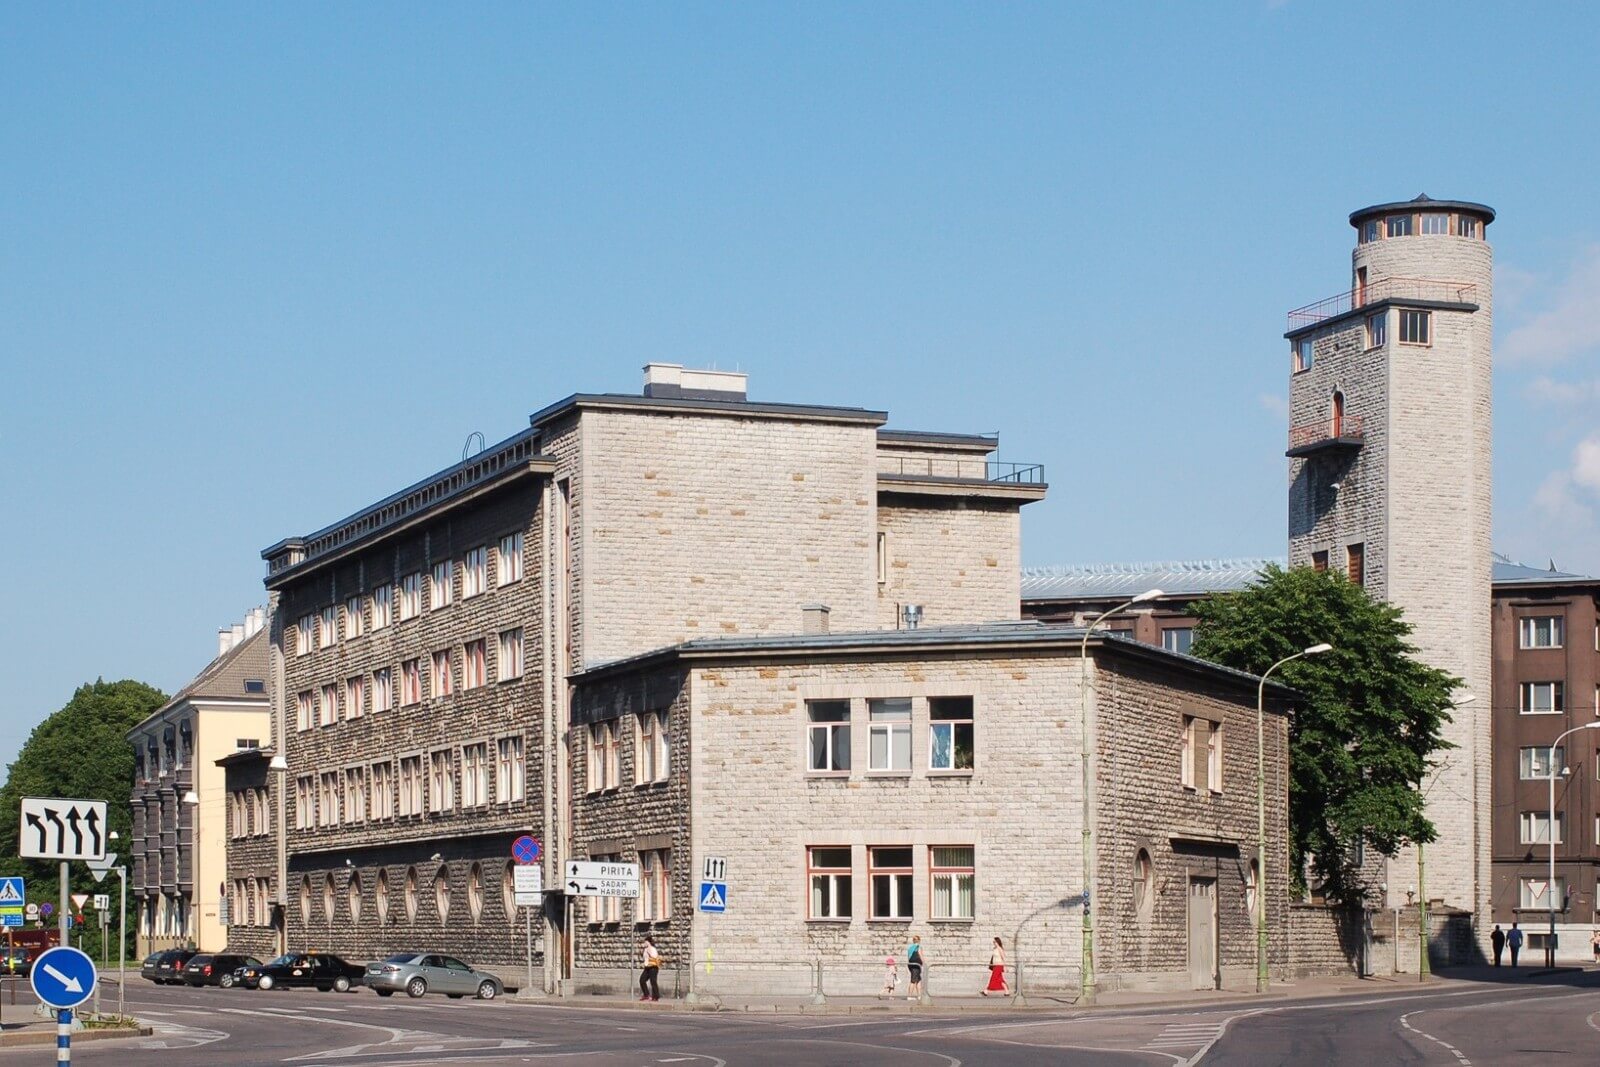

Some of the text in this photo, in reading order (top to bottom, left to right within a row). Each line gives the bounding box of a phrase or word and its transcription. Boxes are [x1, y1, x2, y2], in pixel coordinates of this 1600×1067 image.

[601, 866, 633, 876] PIRITA
[600, 880, 627, 888] SADAM
[600, 888, 637, 896] HARBOUR
